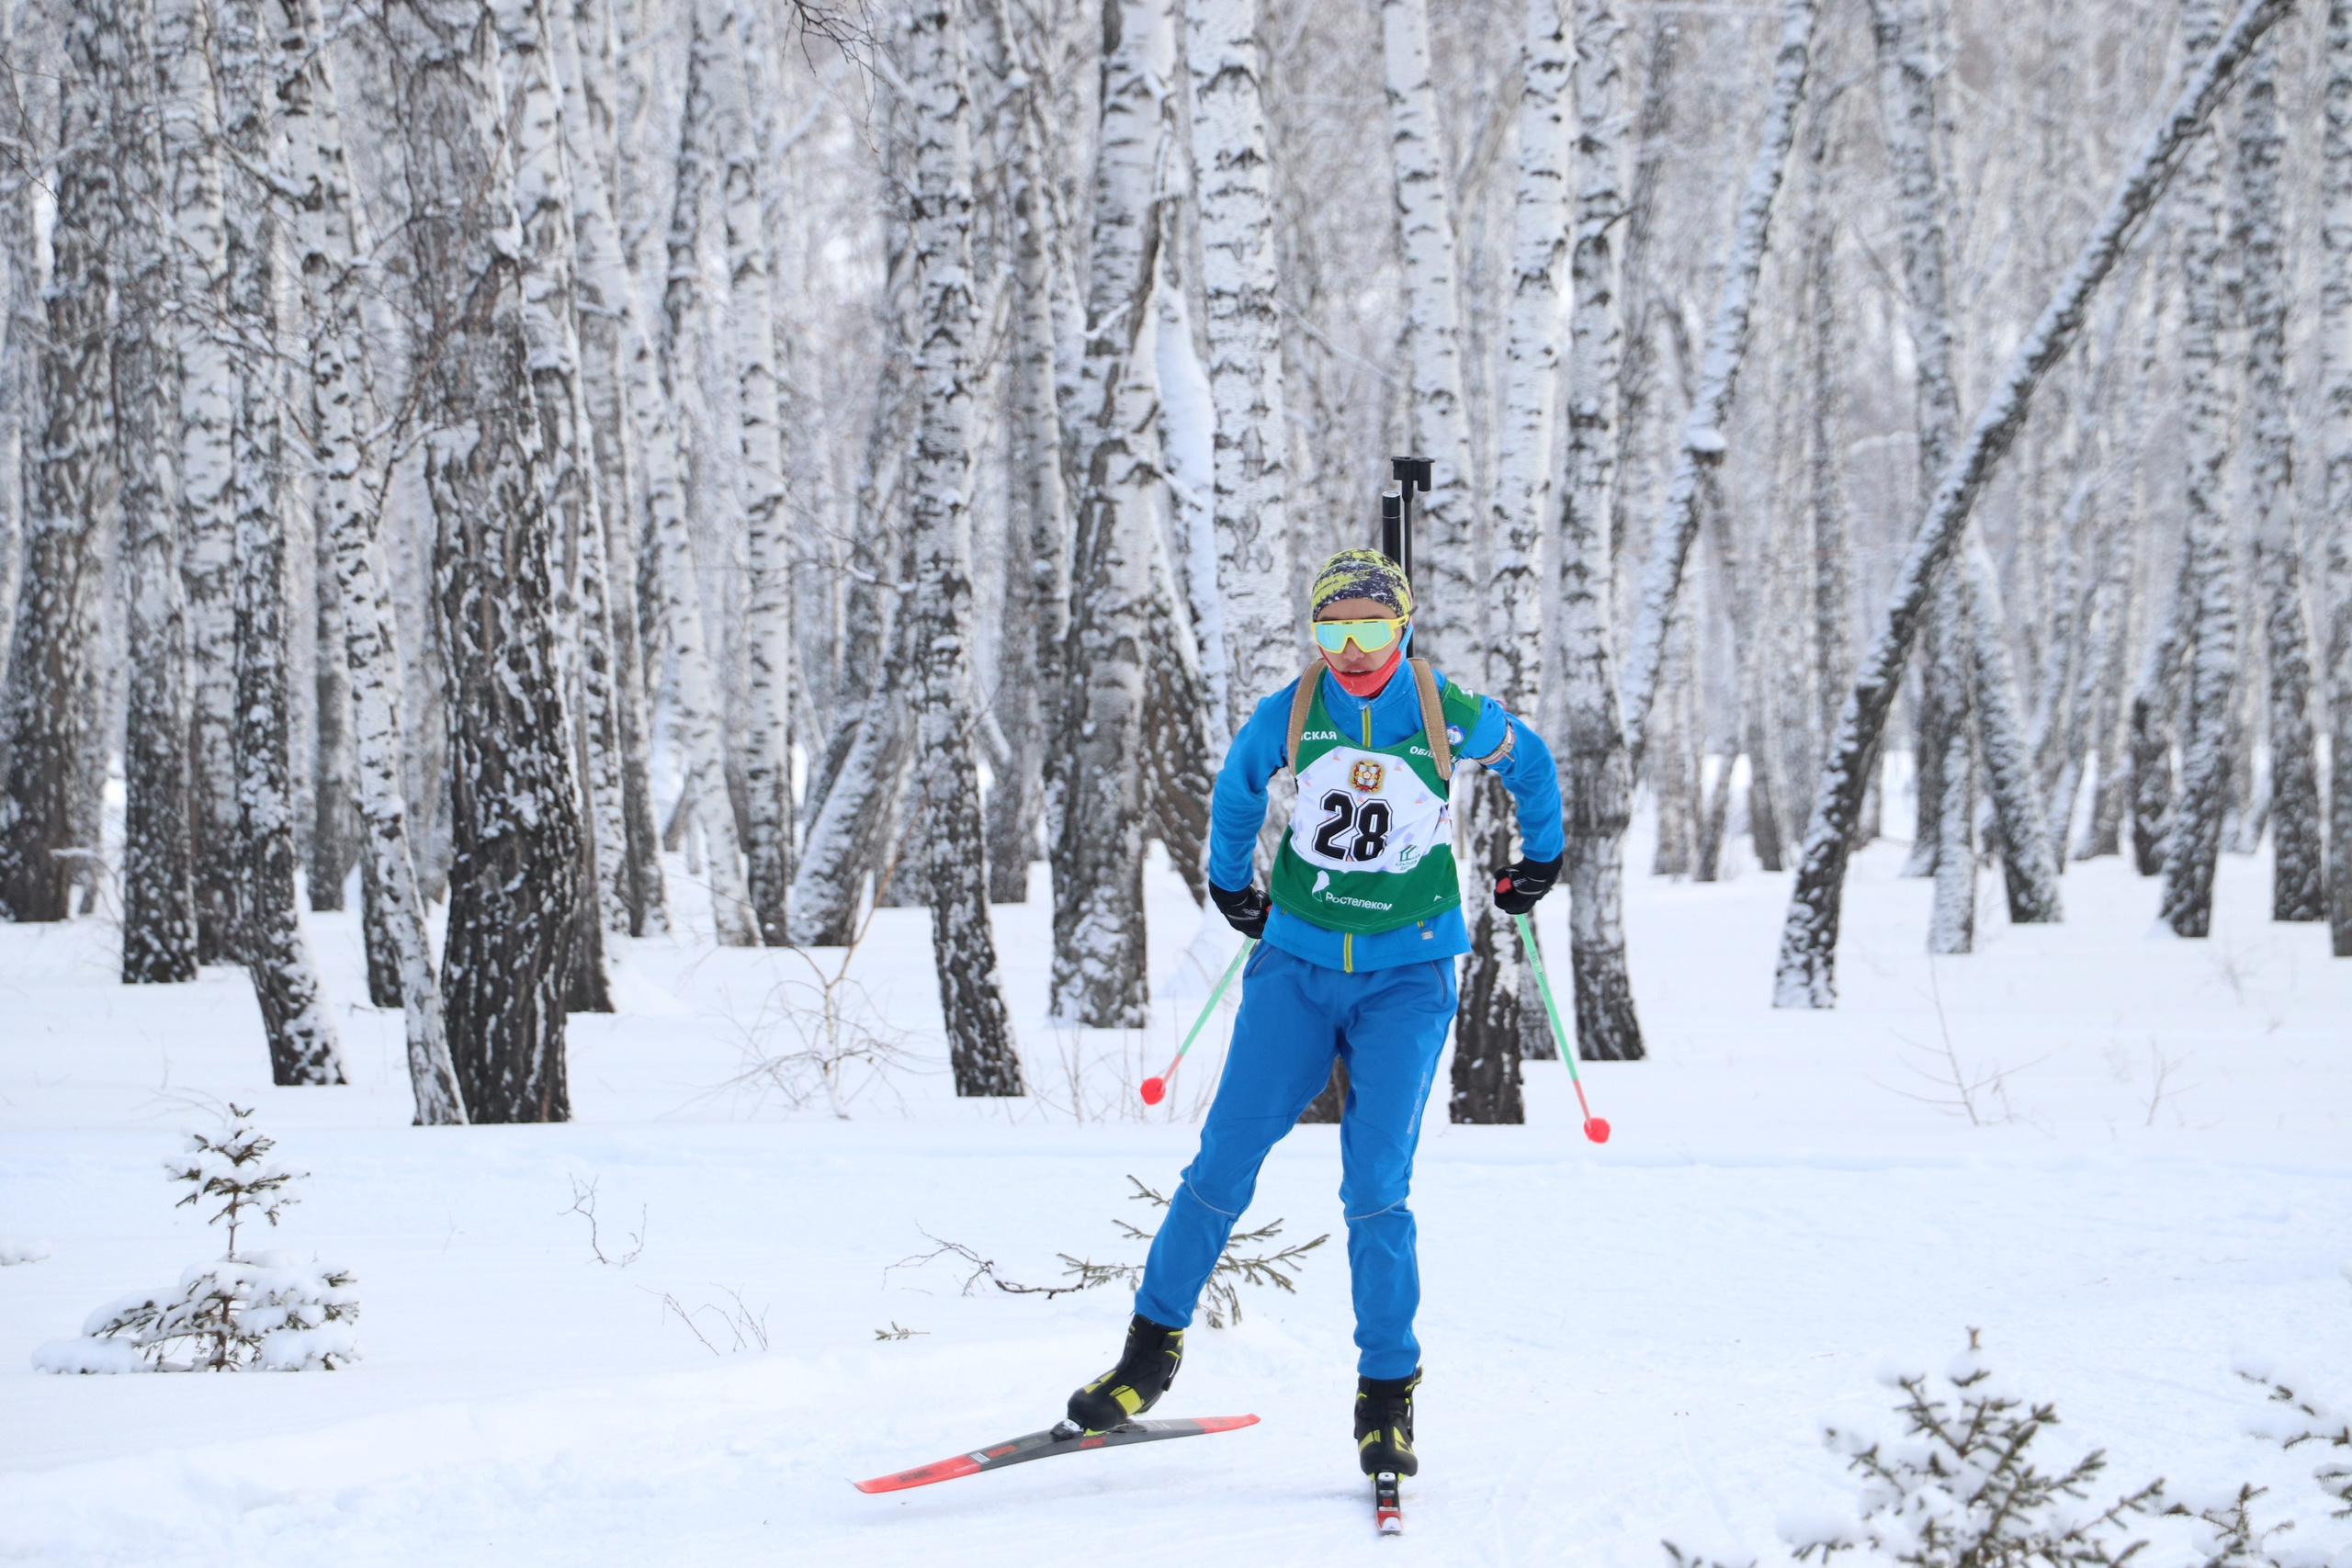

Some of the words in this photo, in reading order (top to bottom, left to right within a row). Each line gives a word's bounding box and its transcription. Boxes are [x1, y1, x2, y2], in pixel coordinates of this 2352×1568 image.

[1300, 730, 1338, 741] СКАЯ
[1311, 788, 1393, 862] 28
[1325, 891, 1393, 911] Ростелеком
